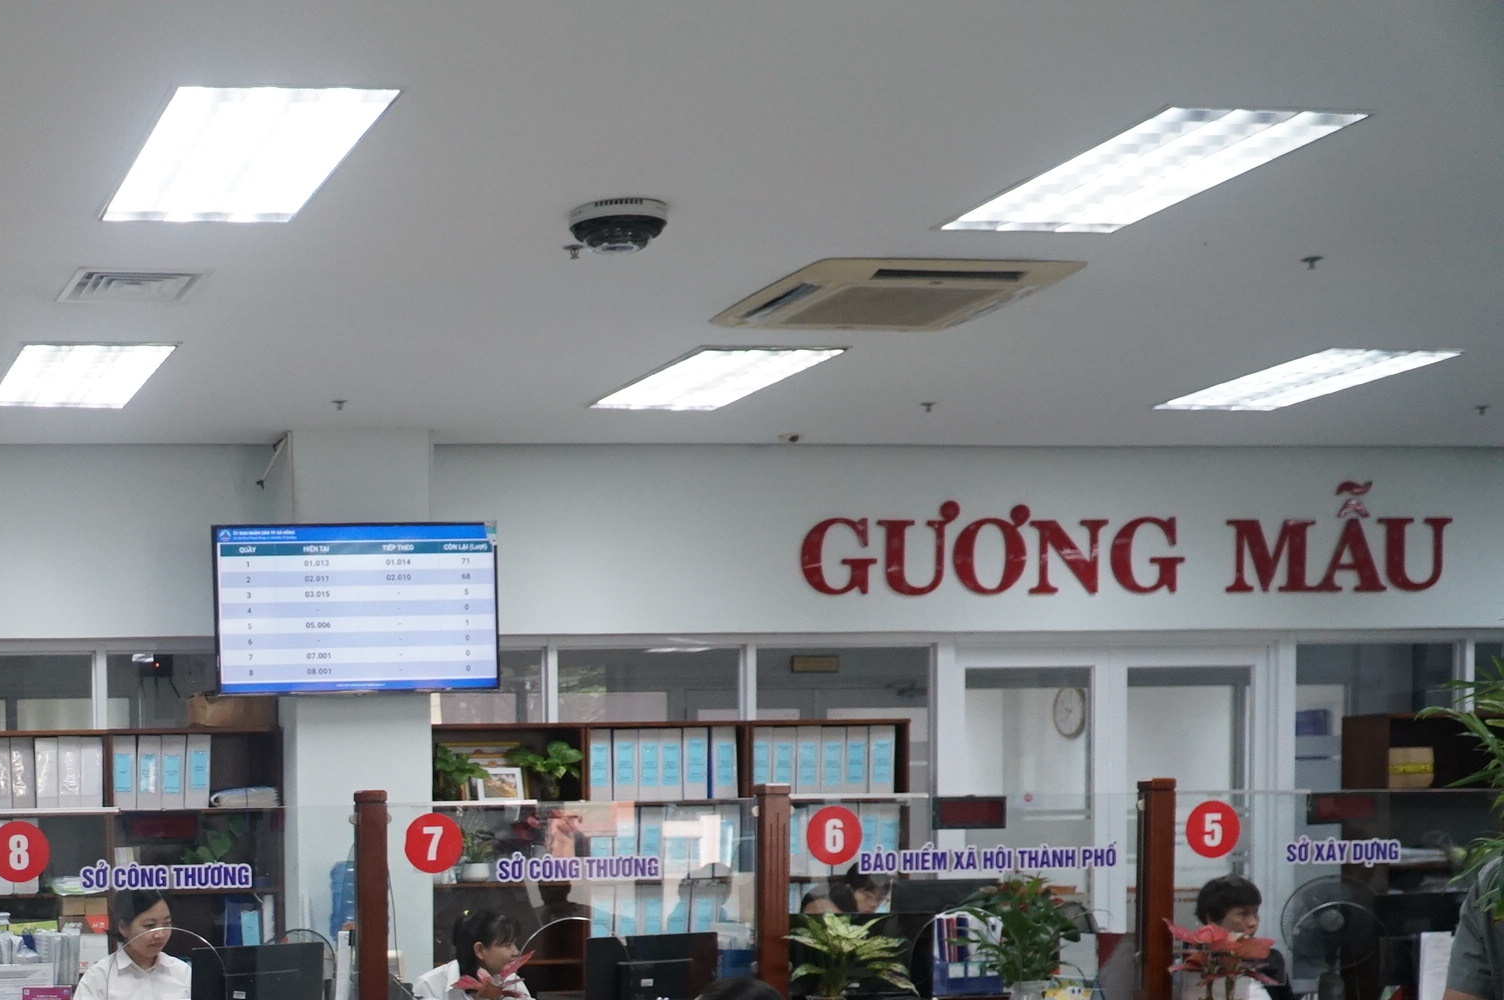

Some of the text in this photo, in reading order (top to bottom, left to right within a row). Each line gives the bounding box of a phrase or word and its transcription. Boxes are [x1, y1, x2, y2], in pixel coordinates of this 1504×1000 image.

[799, 480, 1453, 596] GƯƠNG MẪU
[306, 652, 332, 660] 07.001
[422, 826, 444, 861] 7
[824, 818, 845, 853] 6
[1203, 813, 1223, 848] 5
[8, 834, 30, 871] 8
[498, 853, 659, 881] SỞ CÔNG THƯƠNG
[860, 841, 1118, 875] BẢO HIỂM XÃ HỘI THÀNH PHỐ
[1286, 836, 1400, 867] SỞ XÂY DỰNG
[82, 861, 251, 889] SỞ CÔNG THƯƠNG
